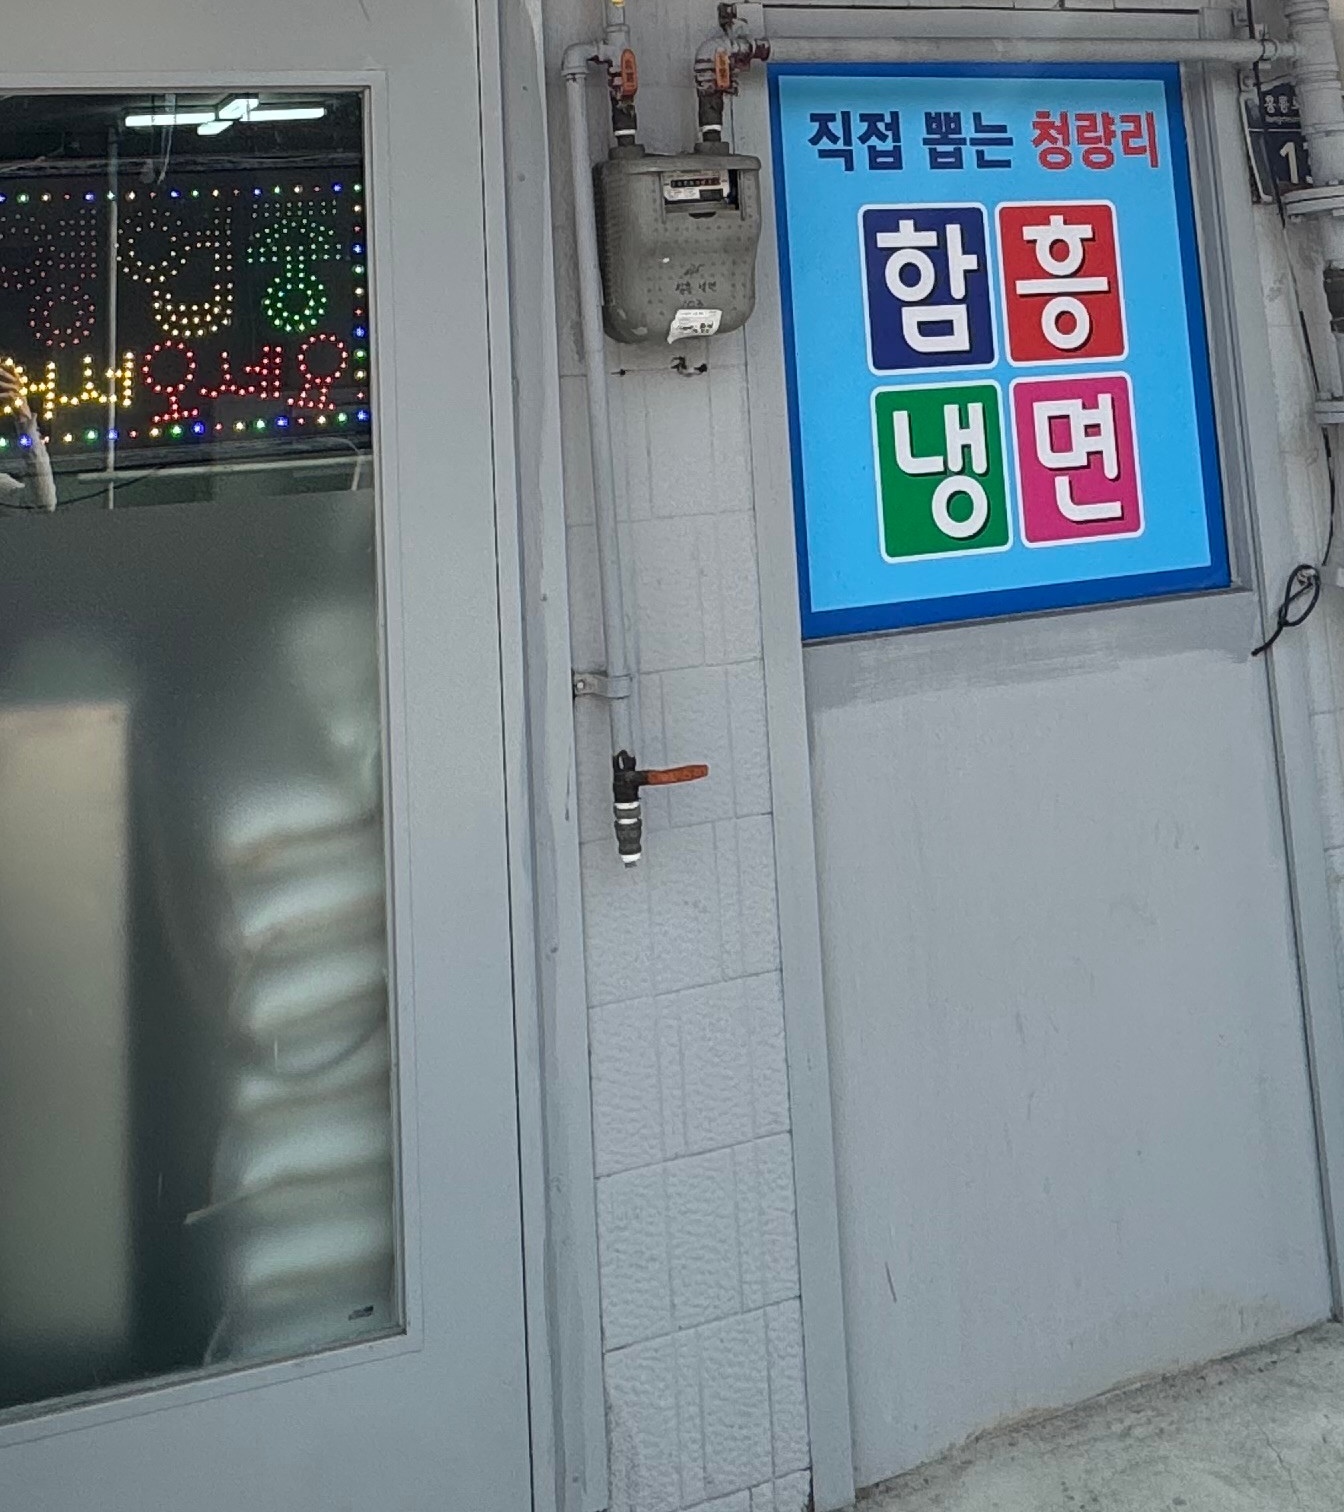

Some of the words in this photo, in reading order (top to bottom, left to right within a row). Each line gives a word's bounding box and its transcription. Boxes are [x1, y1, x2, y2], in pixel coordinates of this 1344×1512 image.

[808, 110, 904, 172] 직접
[922, 110, 1014, 170] 뽑는
[1030, 109, 1160, 170] 청량리
[876, 215, 1109, 355] 함흥
[892, 393, 1124, 539] 냉면
